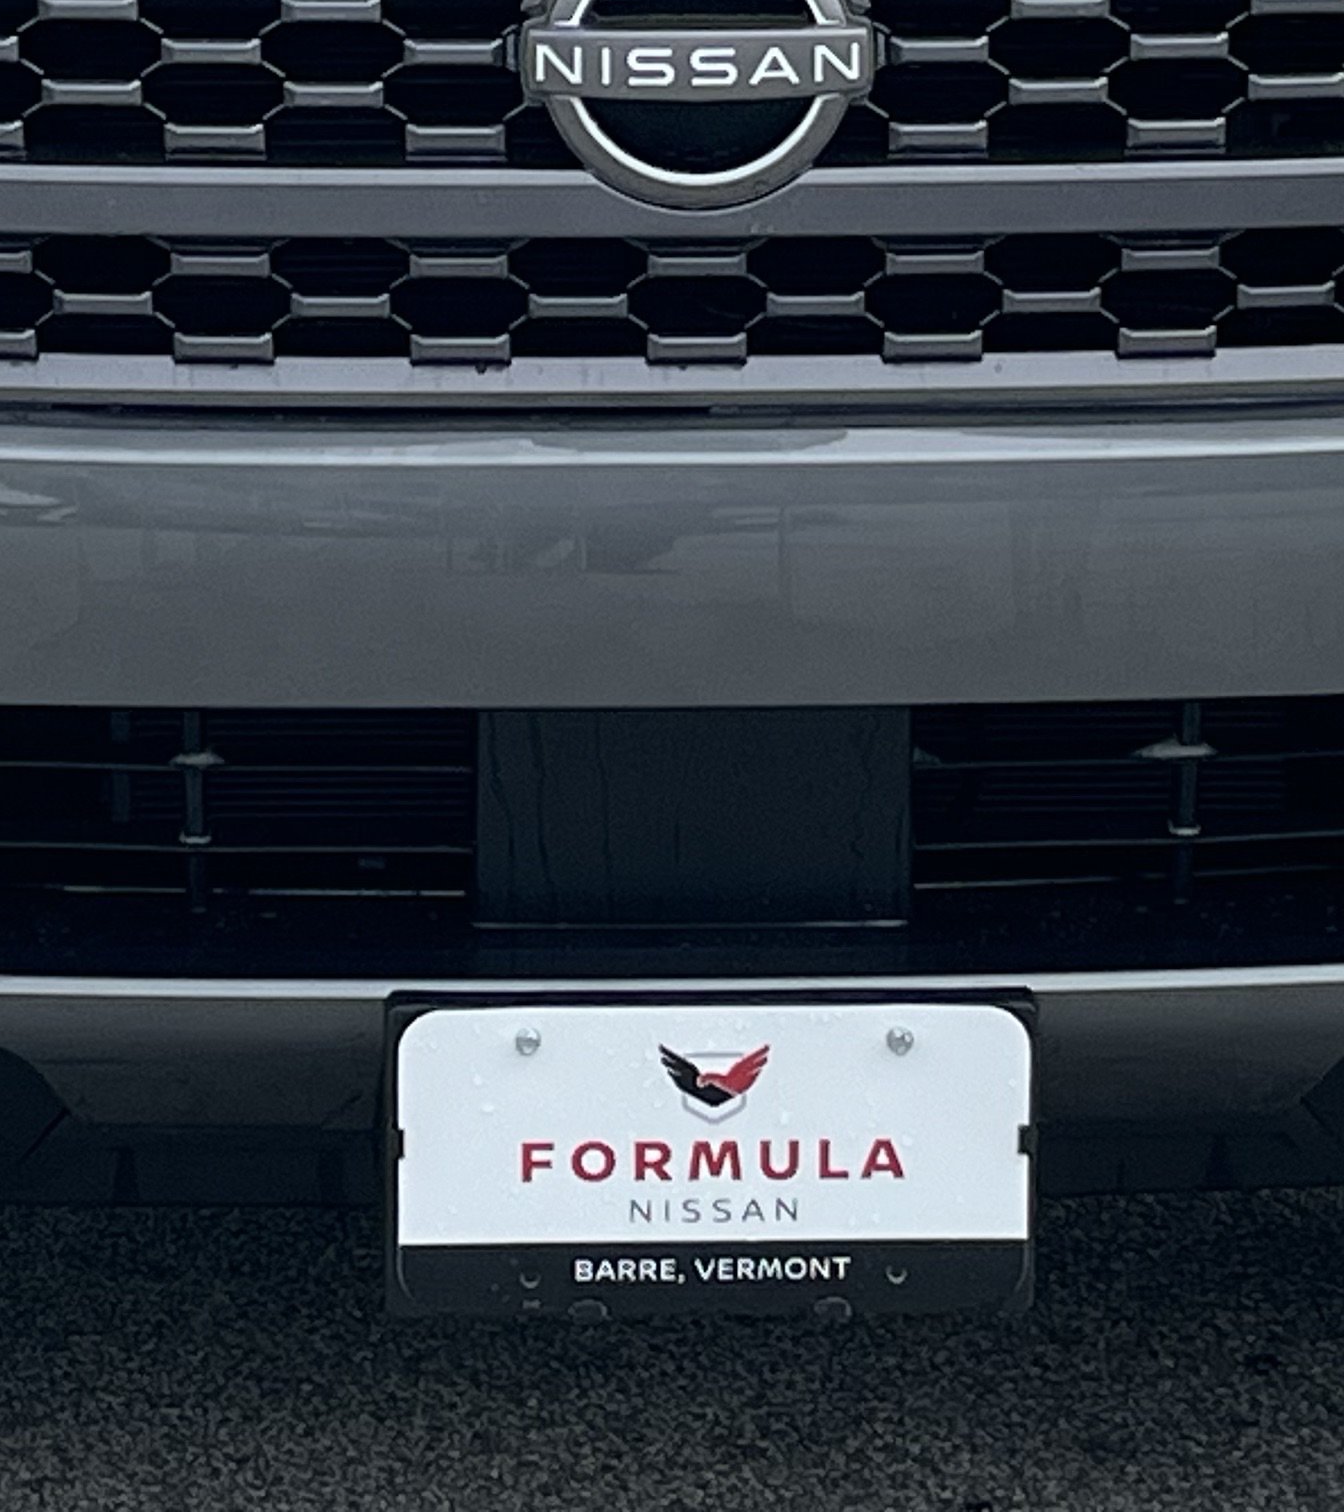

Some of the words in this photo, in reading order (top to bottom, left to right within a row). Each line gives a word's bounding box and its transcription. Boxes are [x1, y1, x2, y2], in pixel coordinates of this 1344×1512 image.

[534, 41, 862, 87] NISSAN
[520, 1137, 905, 1182] FORMULA
[628, 1196, 800, 1225] NISSAN
[573, 1257, 686, 1285] BARRE,
[693, 1255, 852, 1282] VERMONT
